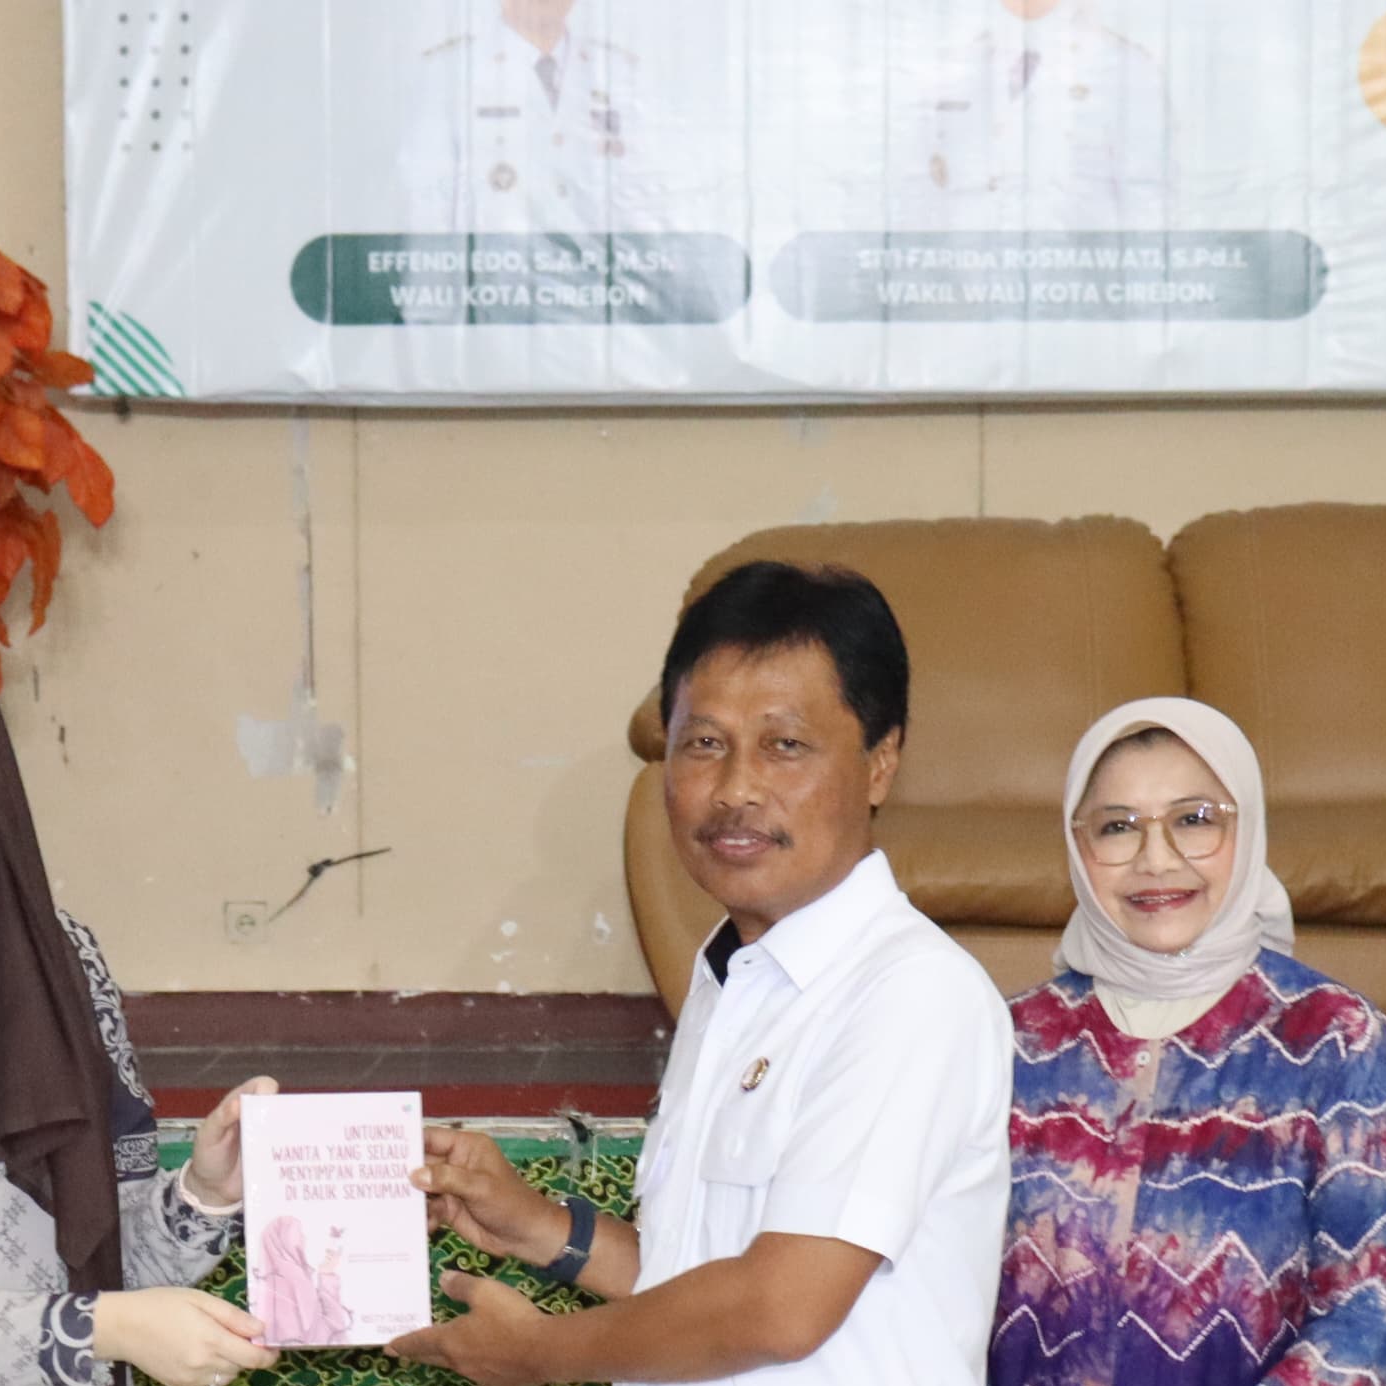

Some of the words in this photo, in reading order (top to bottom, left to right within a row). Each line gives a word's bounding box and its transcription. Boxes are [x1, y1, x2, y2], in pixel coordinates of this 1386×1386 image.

[368, 252, 464, 273] EFFENDI
[471, 252, 528, 275] EDO,
[390, 285, 454, 307] WALI
[463, 285, 530, 307] KOTA
[535, 285, 648, 307] CIREBON
[1031, 282, 1101, 304] KOTA
[1106, 282, 1216, 303] CIREBON
[271, 1144, 320, 1161] WANITA
[326, 1144, 362, 1160] YANG
[367, 1143, 409, 1160] SELALU
[279, 1165, 354, 1181] MENYIMPAN
[285, 1185, 297, 1201] DI
[303, 1184, 337, 1200] BALIK
[342, 1183, 411, 1199] SENYUMAN
